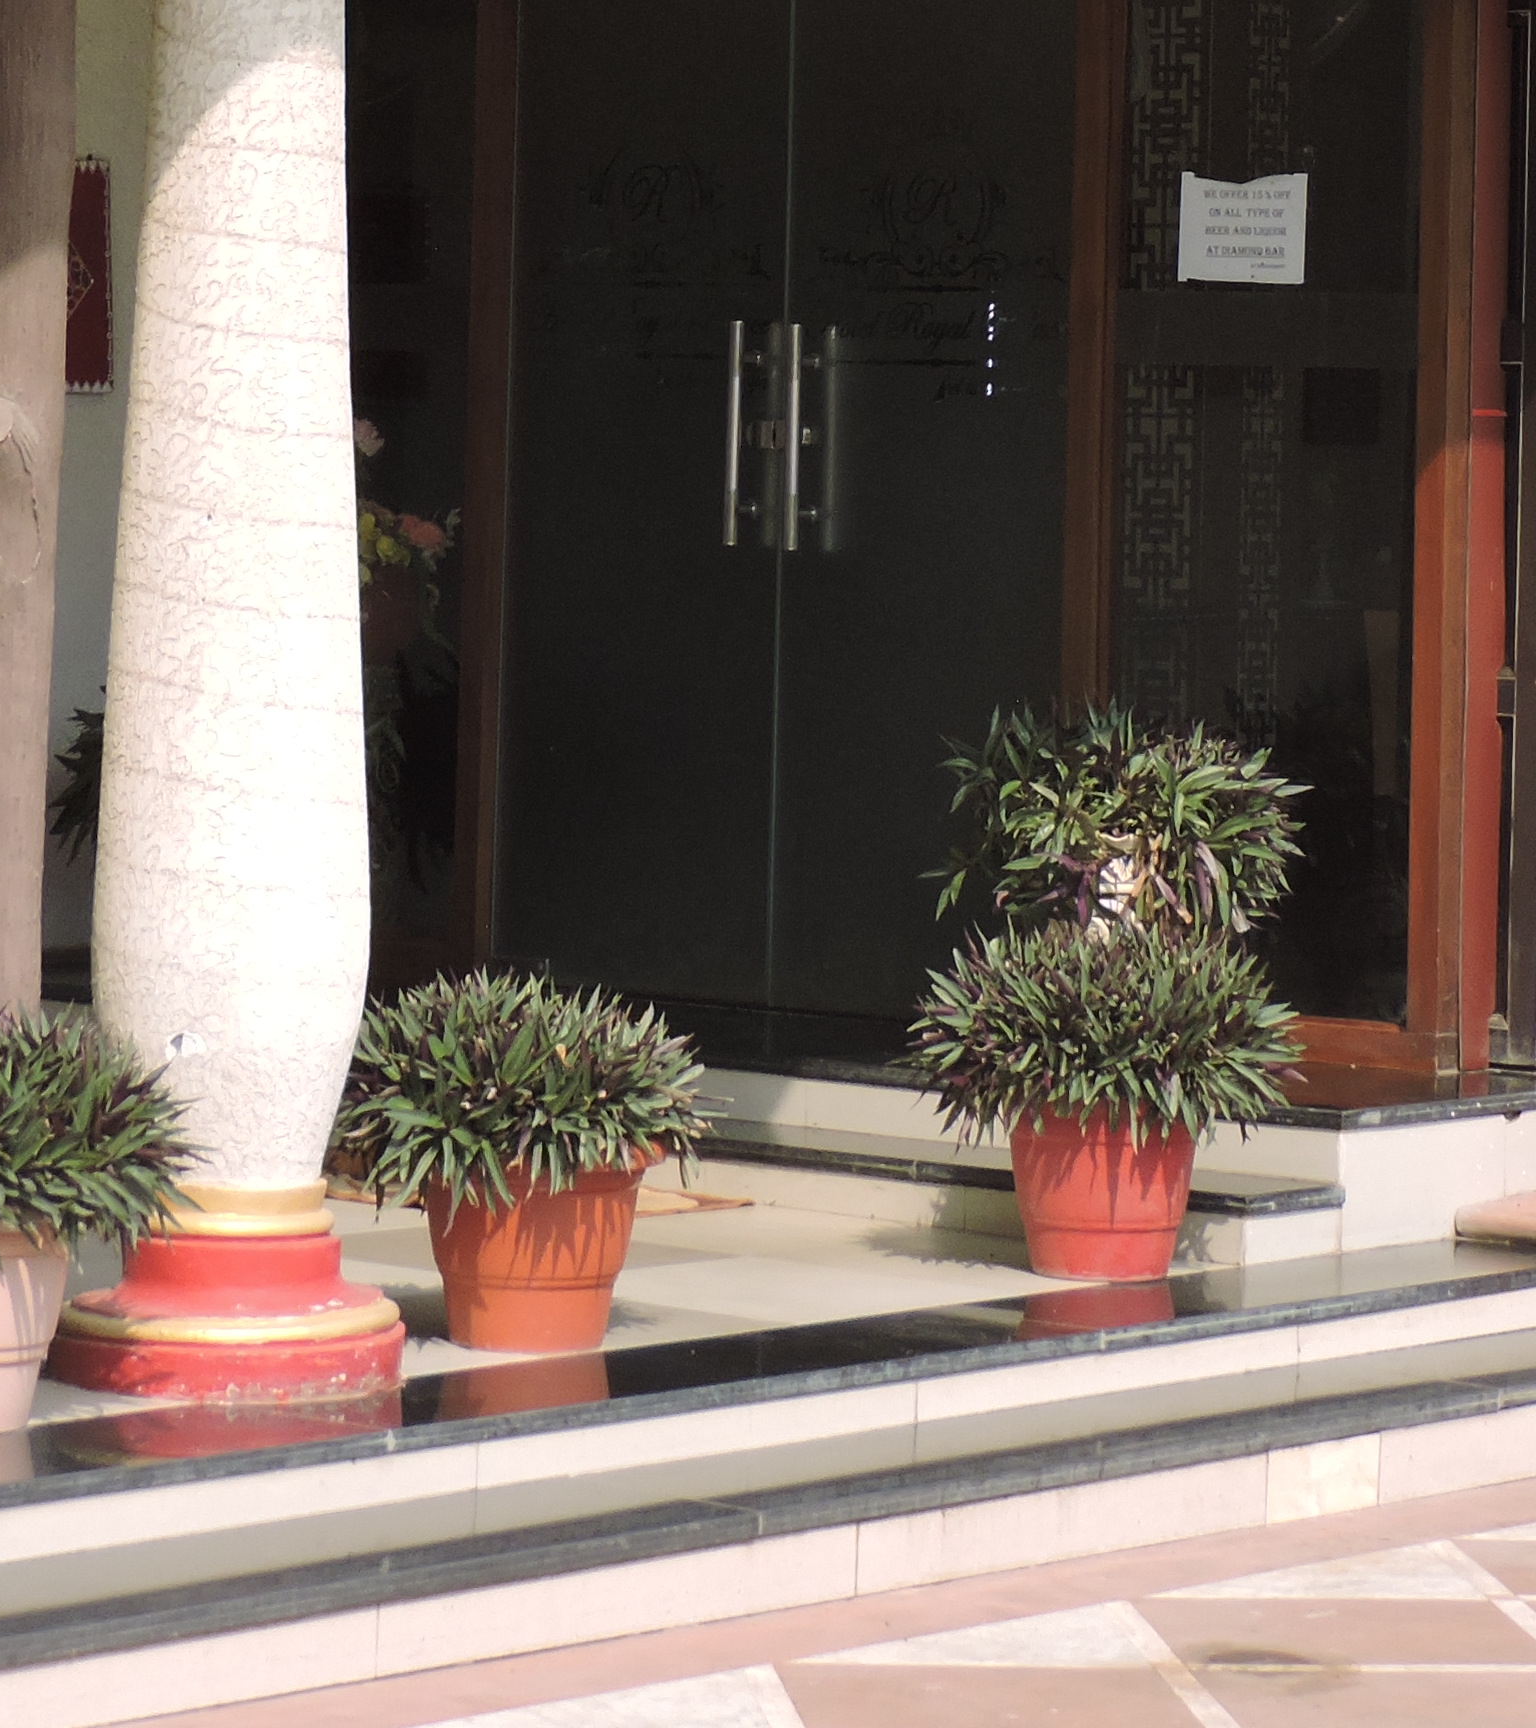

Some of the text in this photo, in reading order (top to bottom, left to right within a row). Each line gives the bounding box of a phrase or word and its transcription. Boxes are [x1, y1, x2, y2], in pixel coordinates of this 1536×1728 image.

[1219, 190, 1248, 199] OFFER
[1273, 190, 1291, 199] OFF
[1209, 208, 1285, 218] ON ALL TYPE OF
[1205, 226, 1230, 235] BEER
[1232, 226, 1252, 236] AND
[1206, 245, 1285, 257] AT DIAMOND BAR
